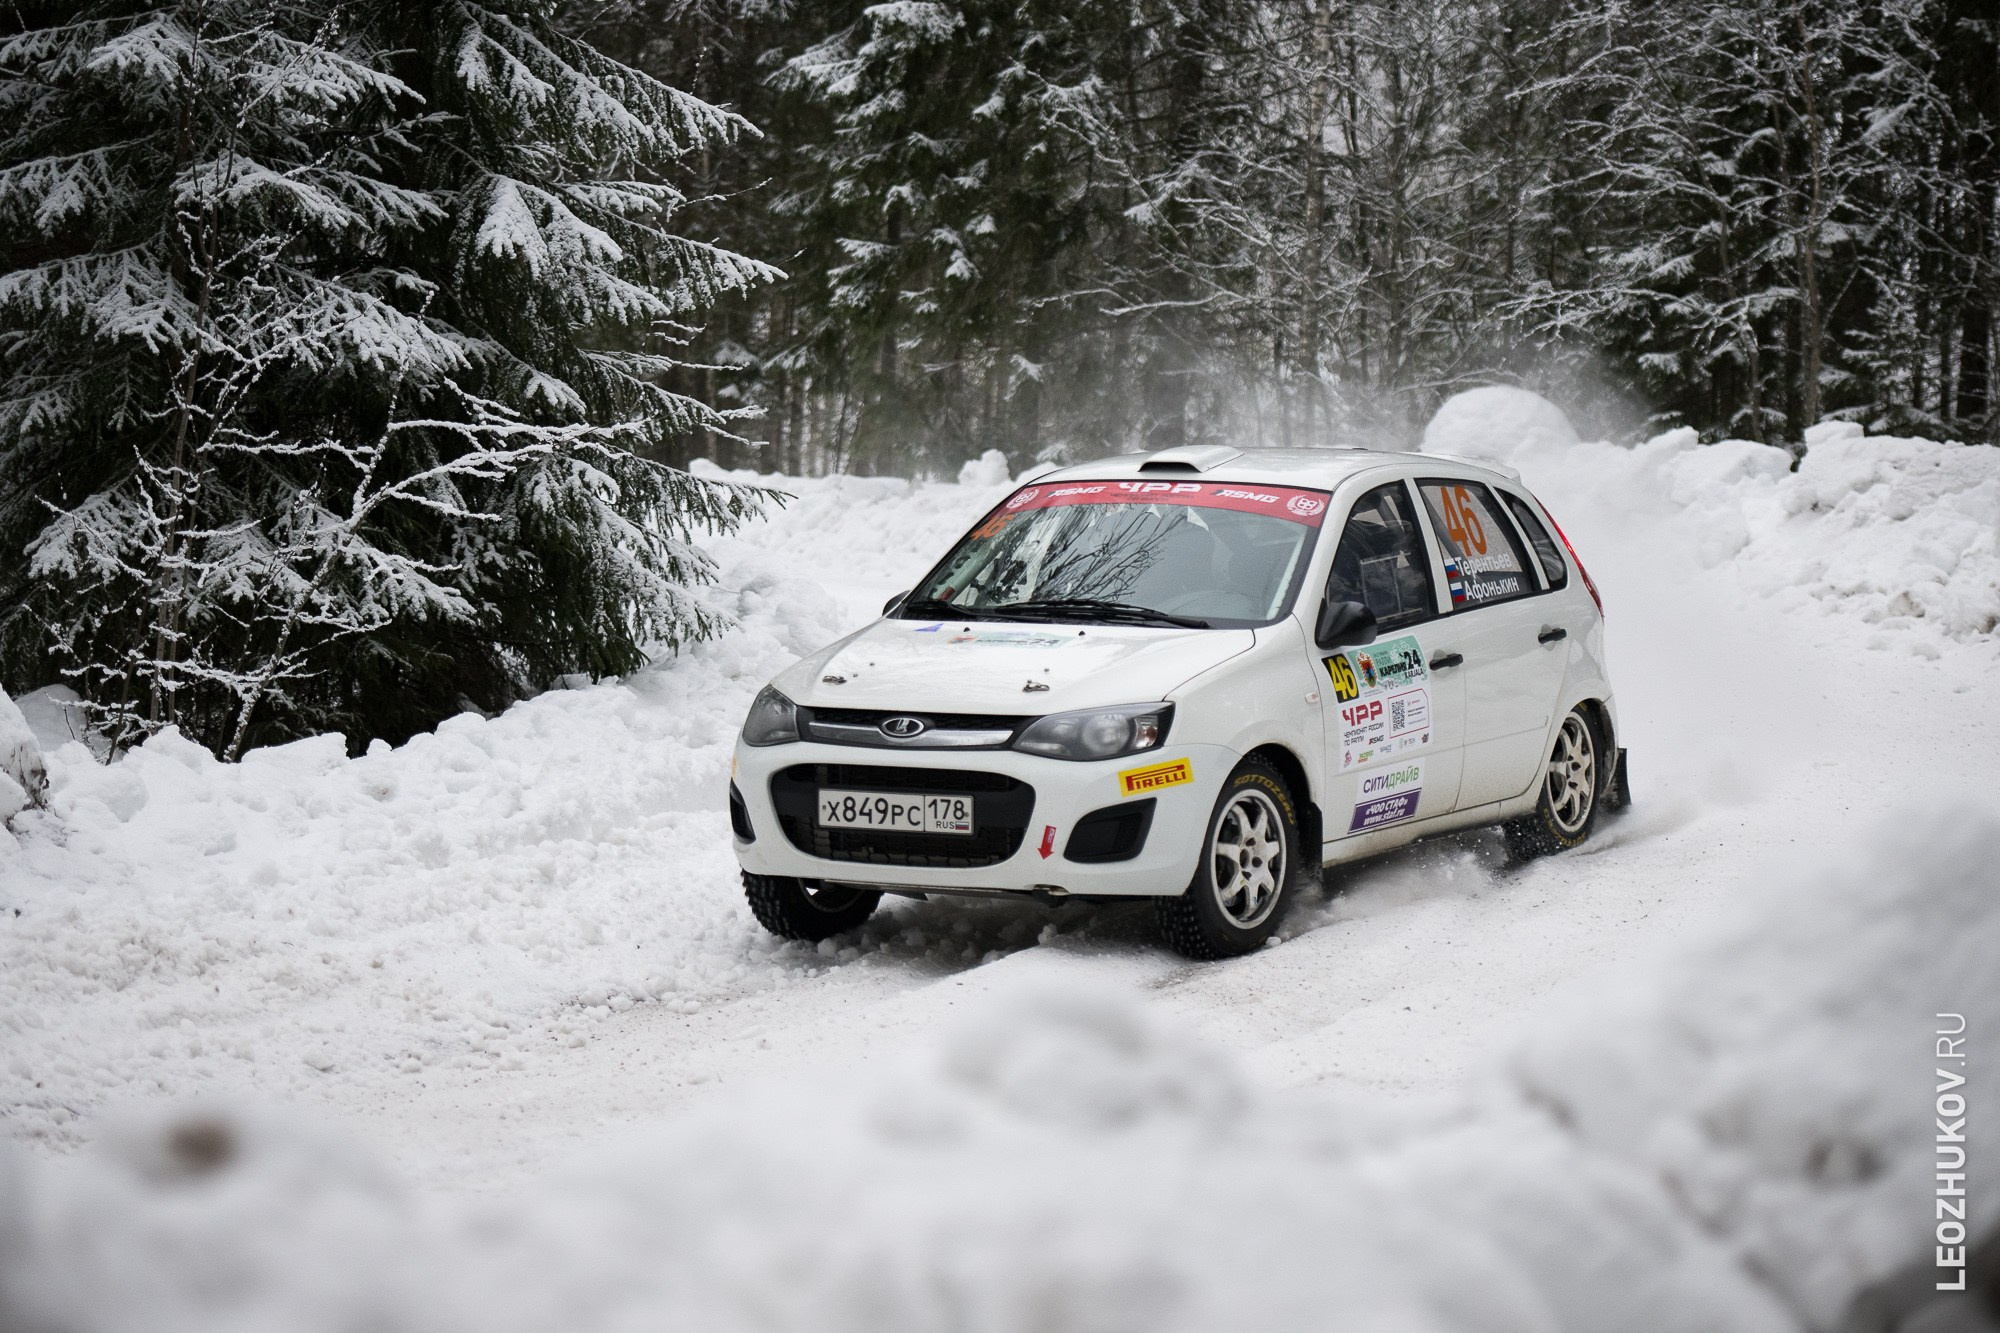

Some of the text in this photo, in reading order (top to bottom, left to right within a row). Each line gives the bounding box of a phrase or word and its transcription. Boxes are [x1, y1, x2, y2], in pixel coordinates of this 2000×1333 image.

[1440, 484, 1487, 557] 46
[1455, 553, 1513, 578] Терентьев
[1464, 576, 1520, 602] Афонькин
[1327, 656, 1358, 700] 46
[1342, 700, 1383, 727] ЧРР
[1126, 764, 1186, 792] PIRELLI
[1363, 765, 1420, 794] СИТИДРАЙВ
[928, 798, 965, 821] 178
[1233, 774, 1294, 825] SOTTOZERO
[936, 820, 955, 830] RUS
